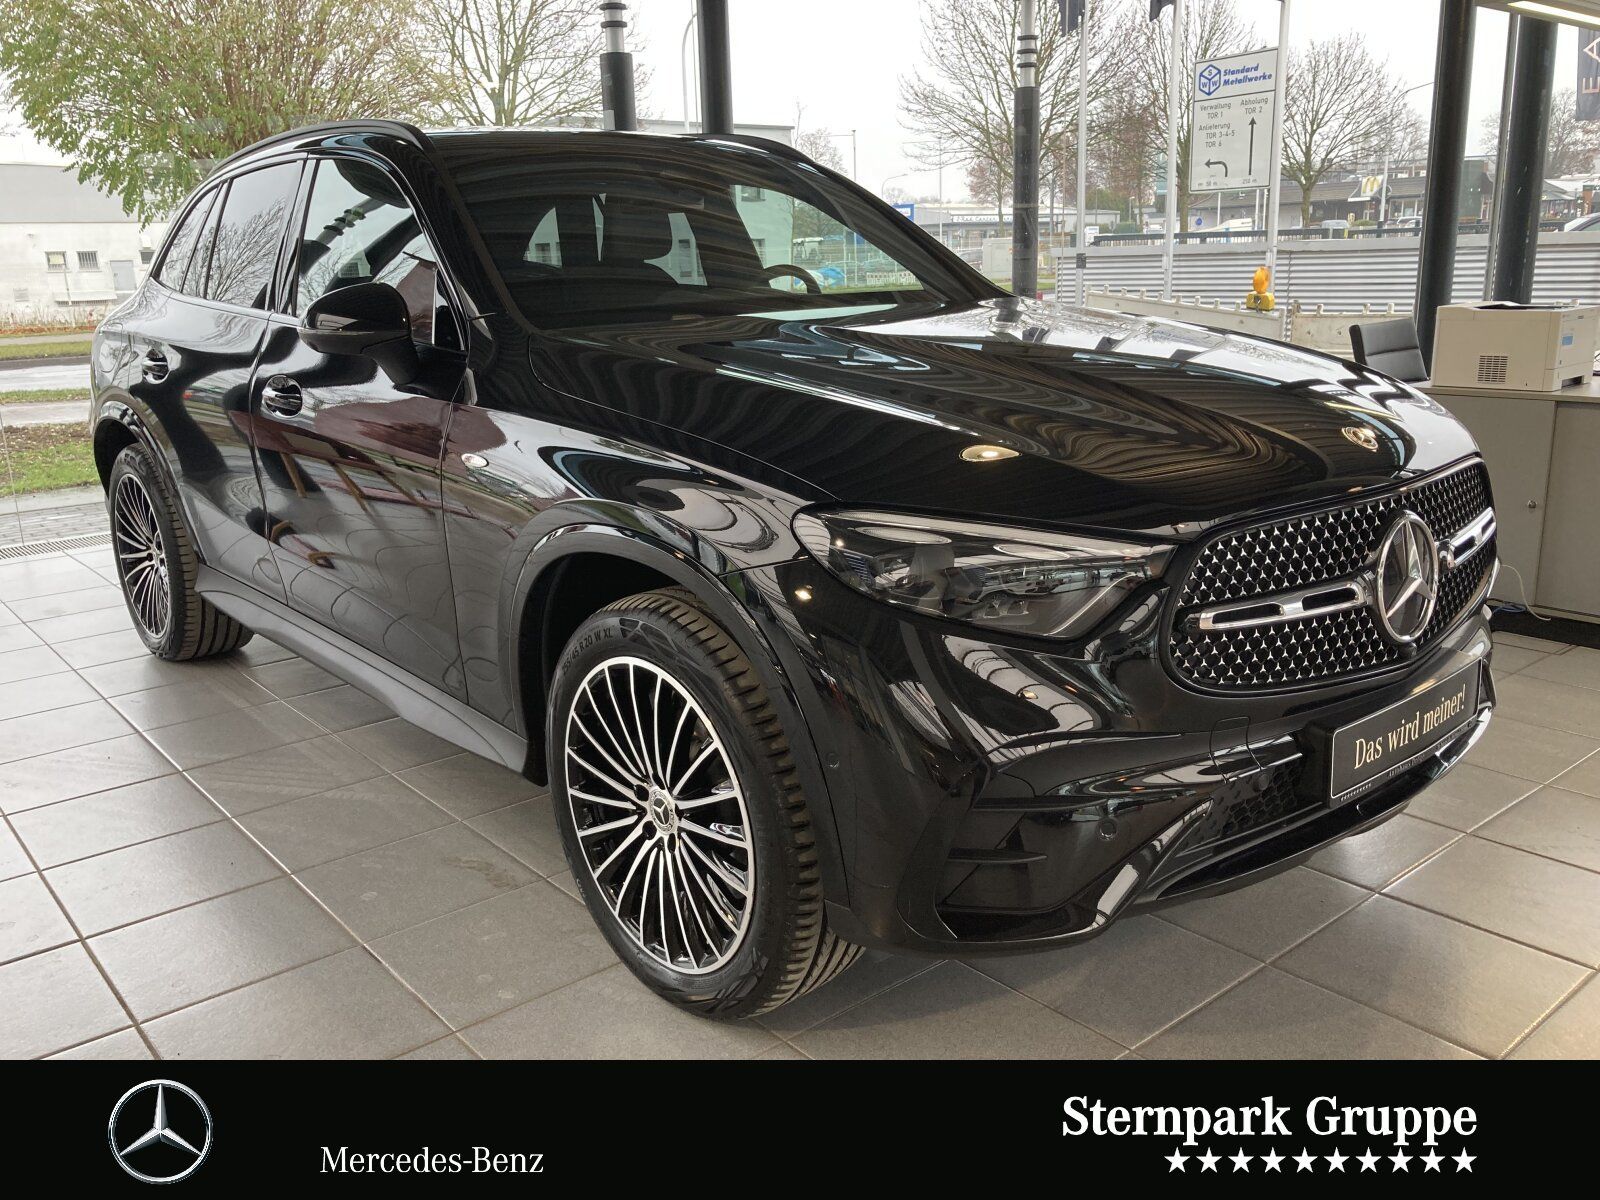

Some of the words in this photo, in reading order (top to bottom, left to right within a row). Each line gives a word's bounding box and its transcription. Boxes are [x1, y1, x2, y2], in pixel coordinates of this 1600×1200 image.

[1223, 63, 1260, 77] Standard
[1222, 72, 1273, 86] Metallwerke
[1240, 97, 1269, 106] Abholung
[1200, 102, 1232, 112] Verwaltung
[1245, 107, 1257, 115] TOR
[1198, 122, 1231, 132] Anlieferung
[1219, 129, 1236, 138] 3-4-5
[603, 627, 614, 639] XL
[1354, 736, 1383, 769] Das
[1388, 711, 1420, 752] wird
[1423, 683, 1466, 734] meiner!
